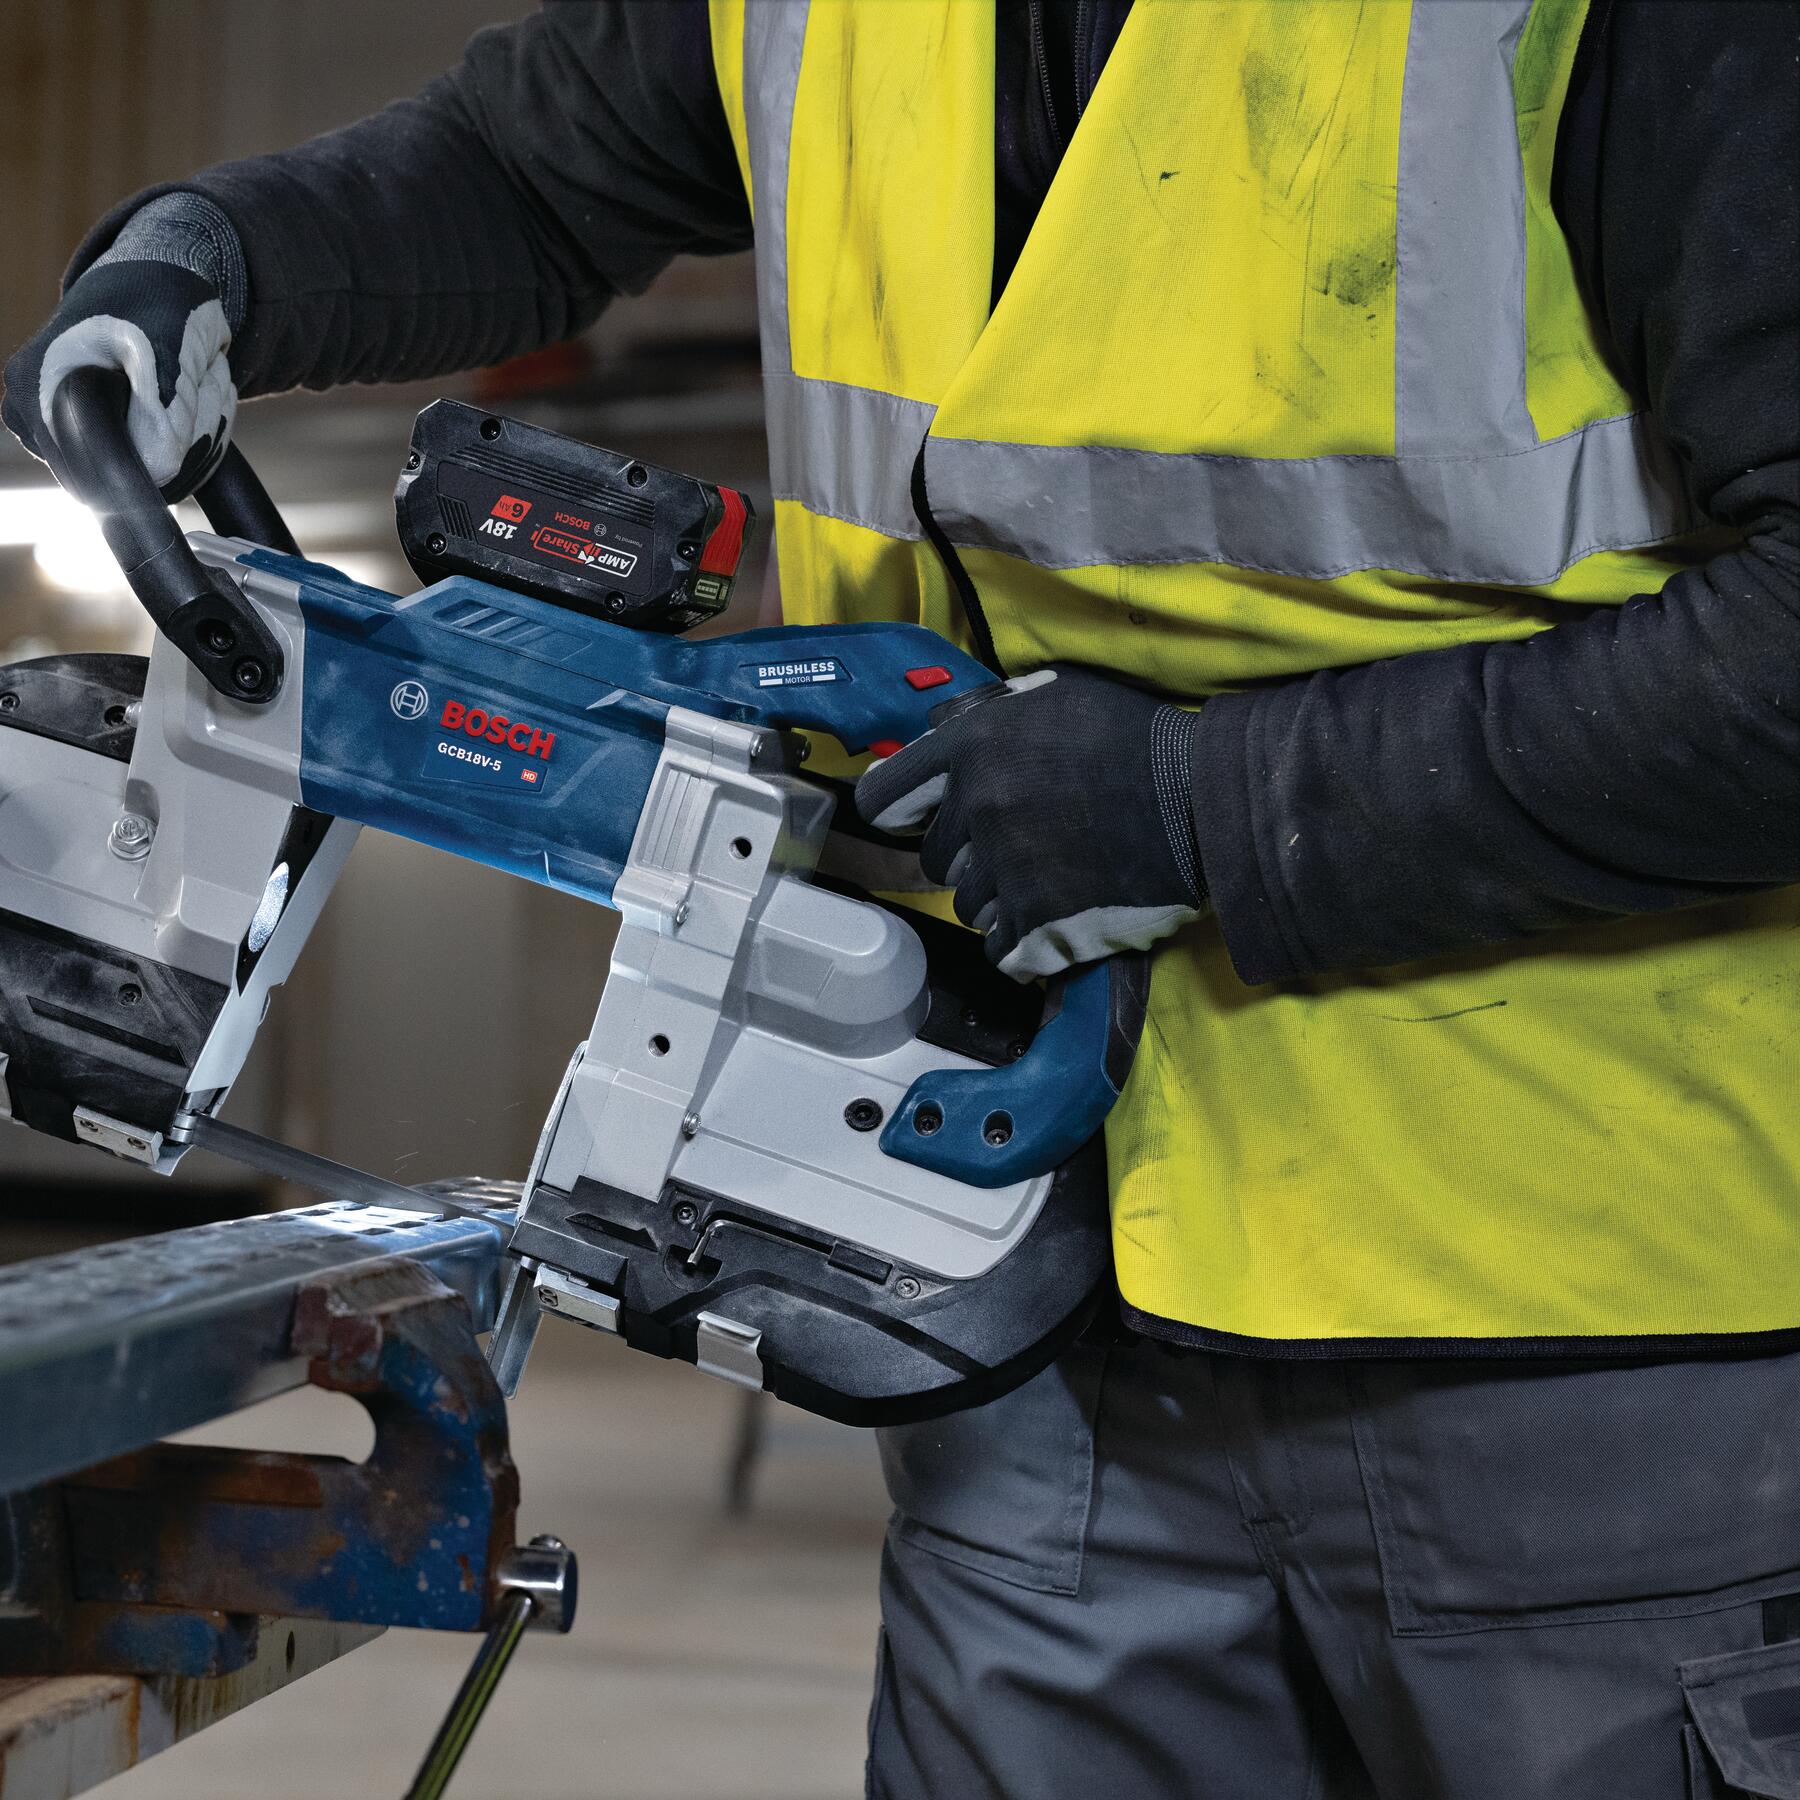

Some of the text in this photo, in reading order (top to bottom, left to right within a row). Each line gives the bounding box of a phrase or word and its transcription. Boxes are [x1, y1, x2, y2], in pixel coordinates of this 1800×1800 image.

[500, 501, 524, 518] 6 Ah
[478, 518, 518, 540] 18V
[554, 511, 591, 531] BOSCH
[542, 533, 631, 570] AMP Share
[622, 537, 643, 548] Powered
[758, 661, 835, 677] BRUSHLESS
[785, 676, 811, 684] MOTOR
[440, 699, 557, 761] BOSCH
[437, 742, 502, 772] GCB18V-5
[523, 771, 536, 781] HD
